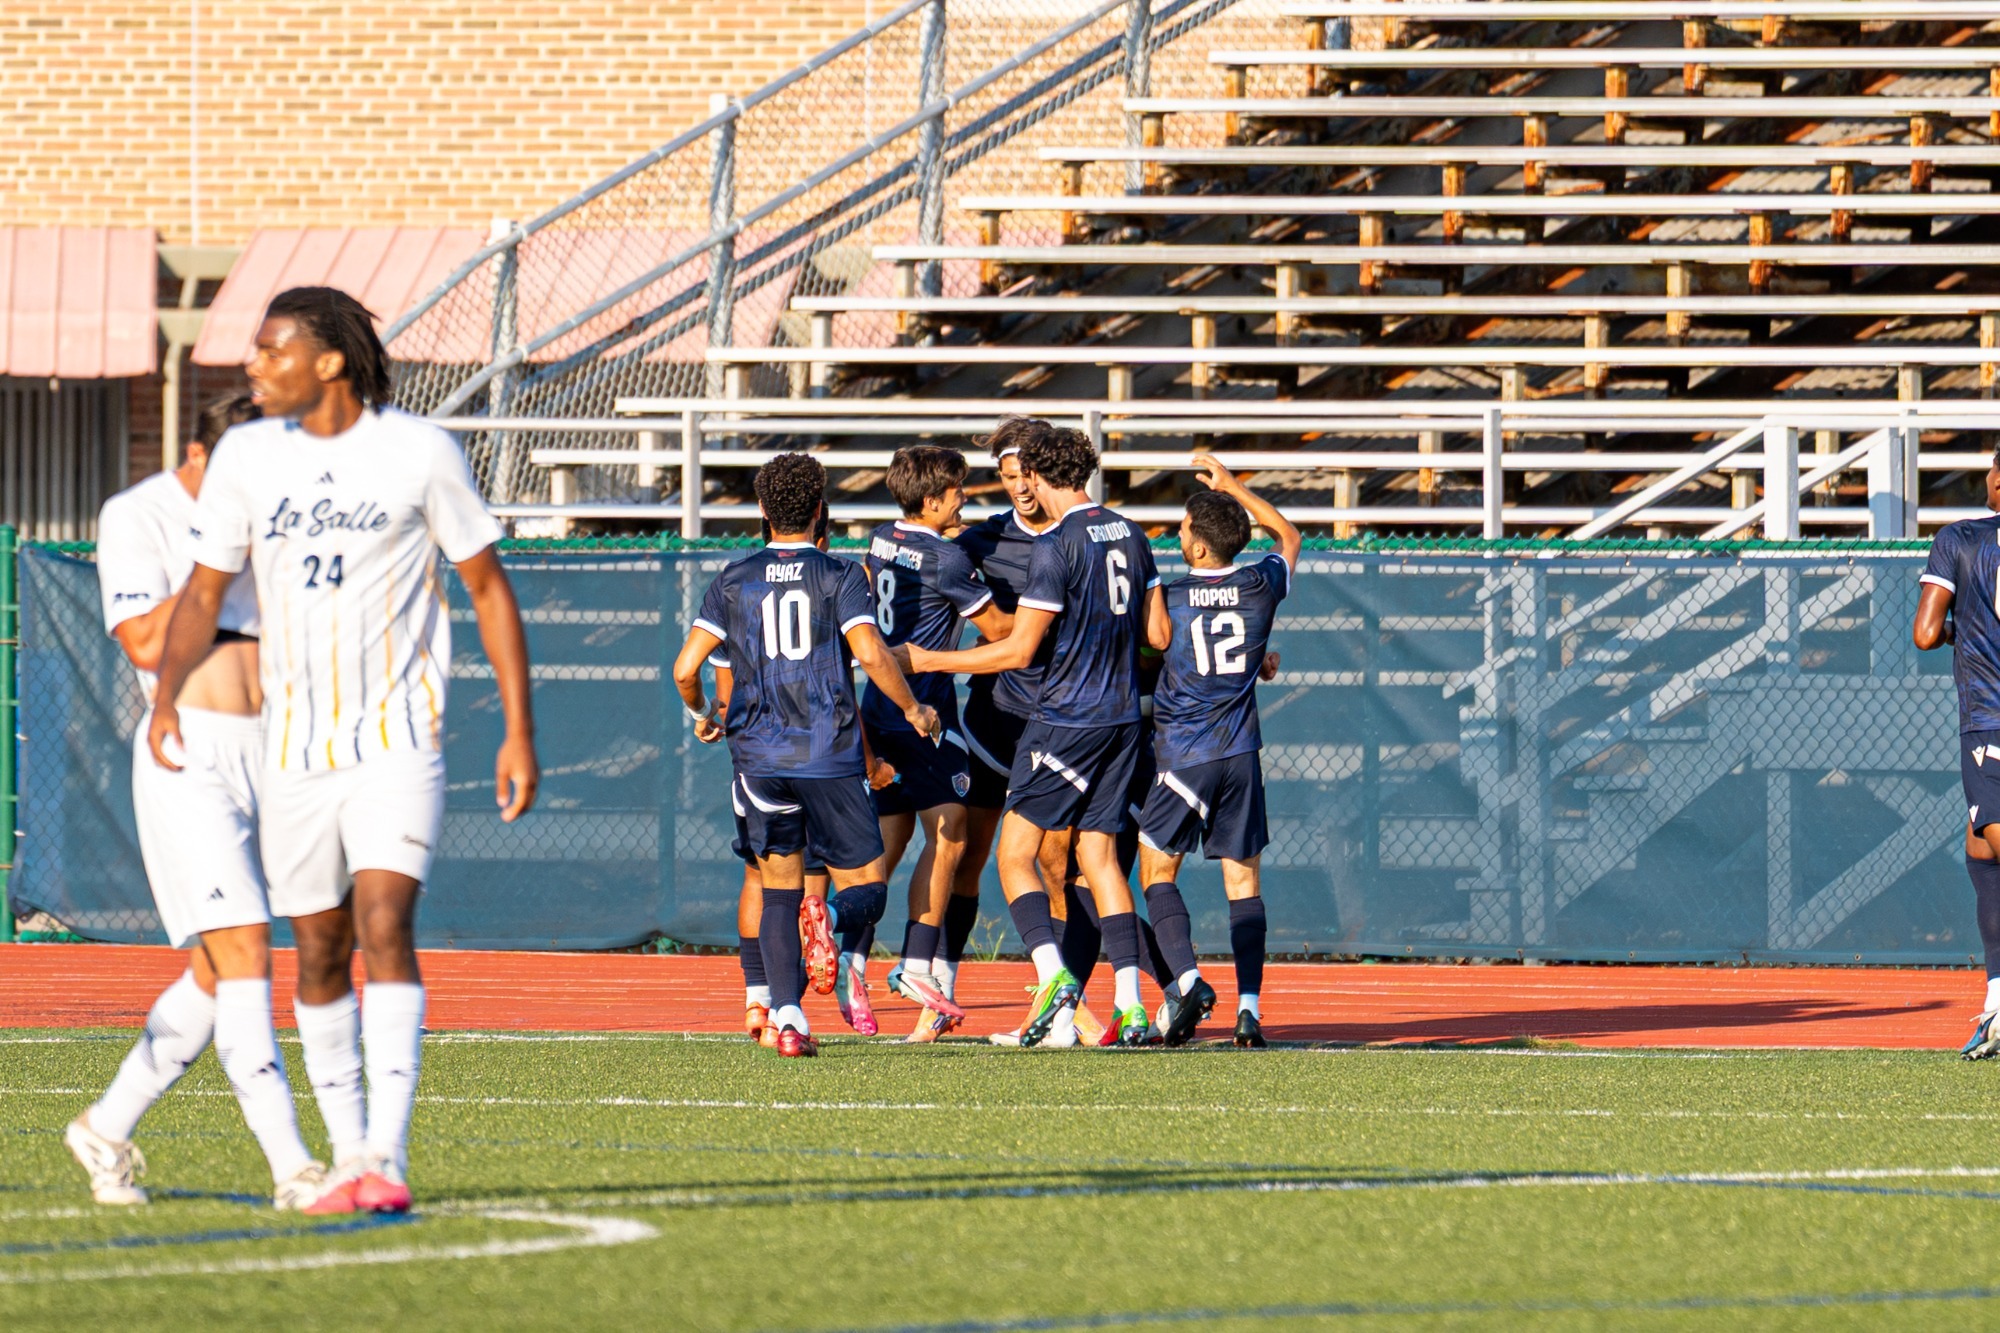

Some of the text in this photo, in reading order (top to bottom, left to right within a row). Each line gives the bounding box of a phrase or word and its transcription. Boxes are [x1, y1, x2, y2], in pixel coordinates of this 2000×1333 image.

[265, 497, 391, 540] La Salle
[303, 554, 343, 589] 24
[765, 562, 804, 582] AYAZ
[1105, 549, 1131, 615] 6
[1189, 586, 1240, 607] KOPAY
[761, 589, 812, 661] 10
[877, 568, 897, 636] 8
[1190, 611, 1246, 676] 12
